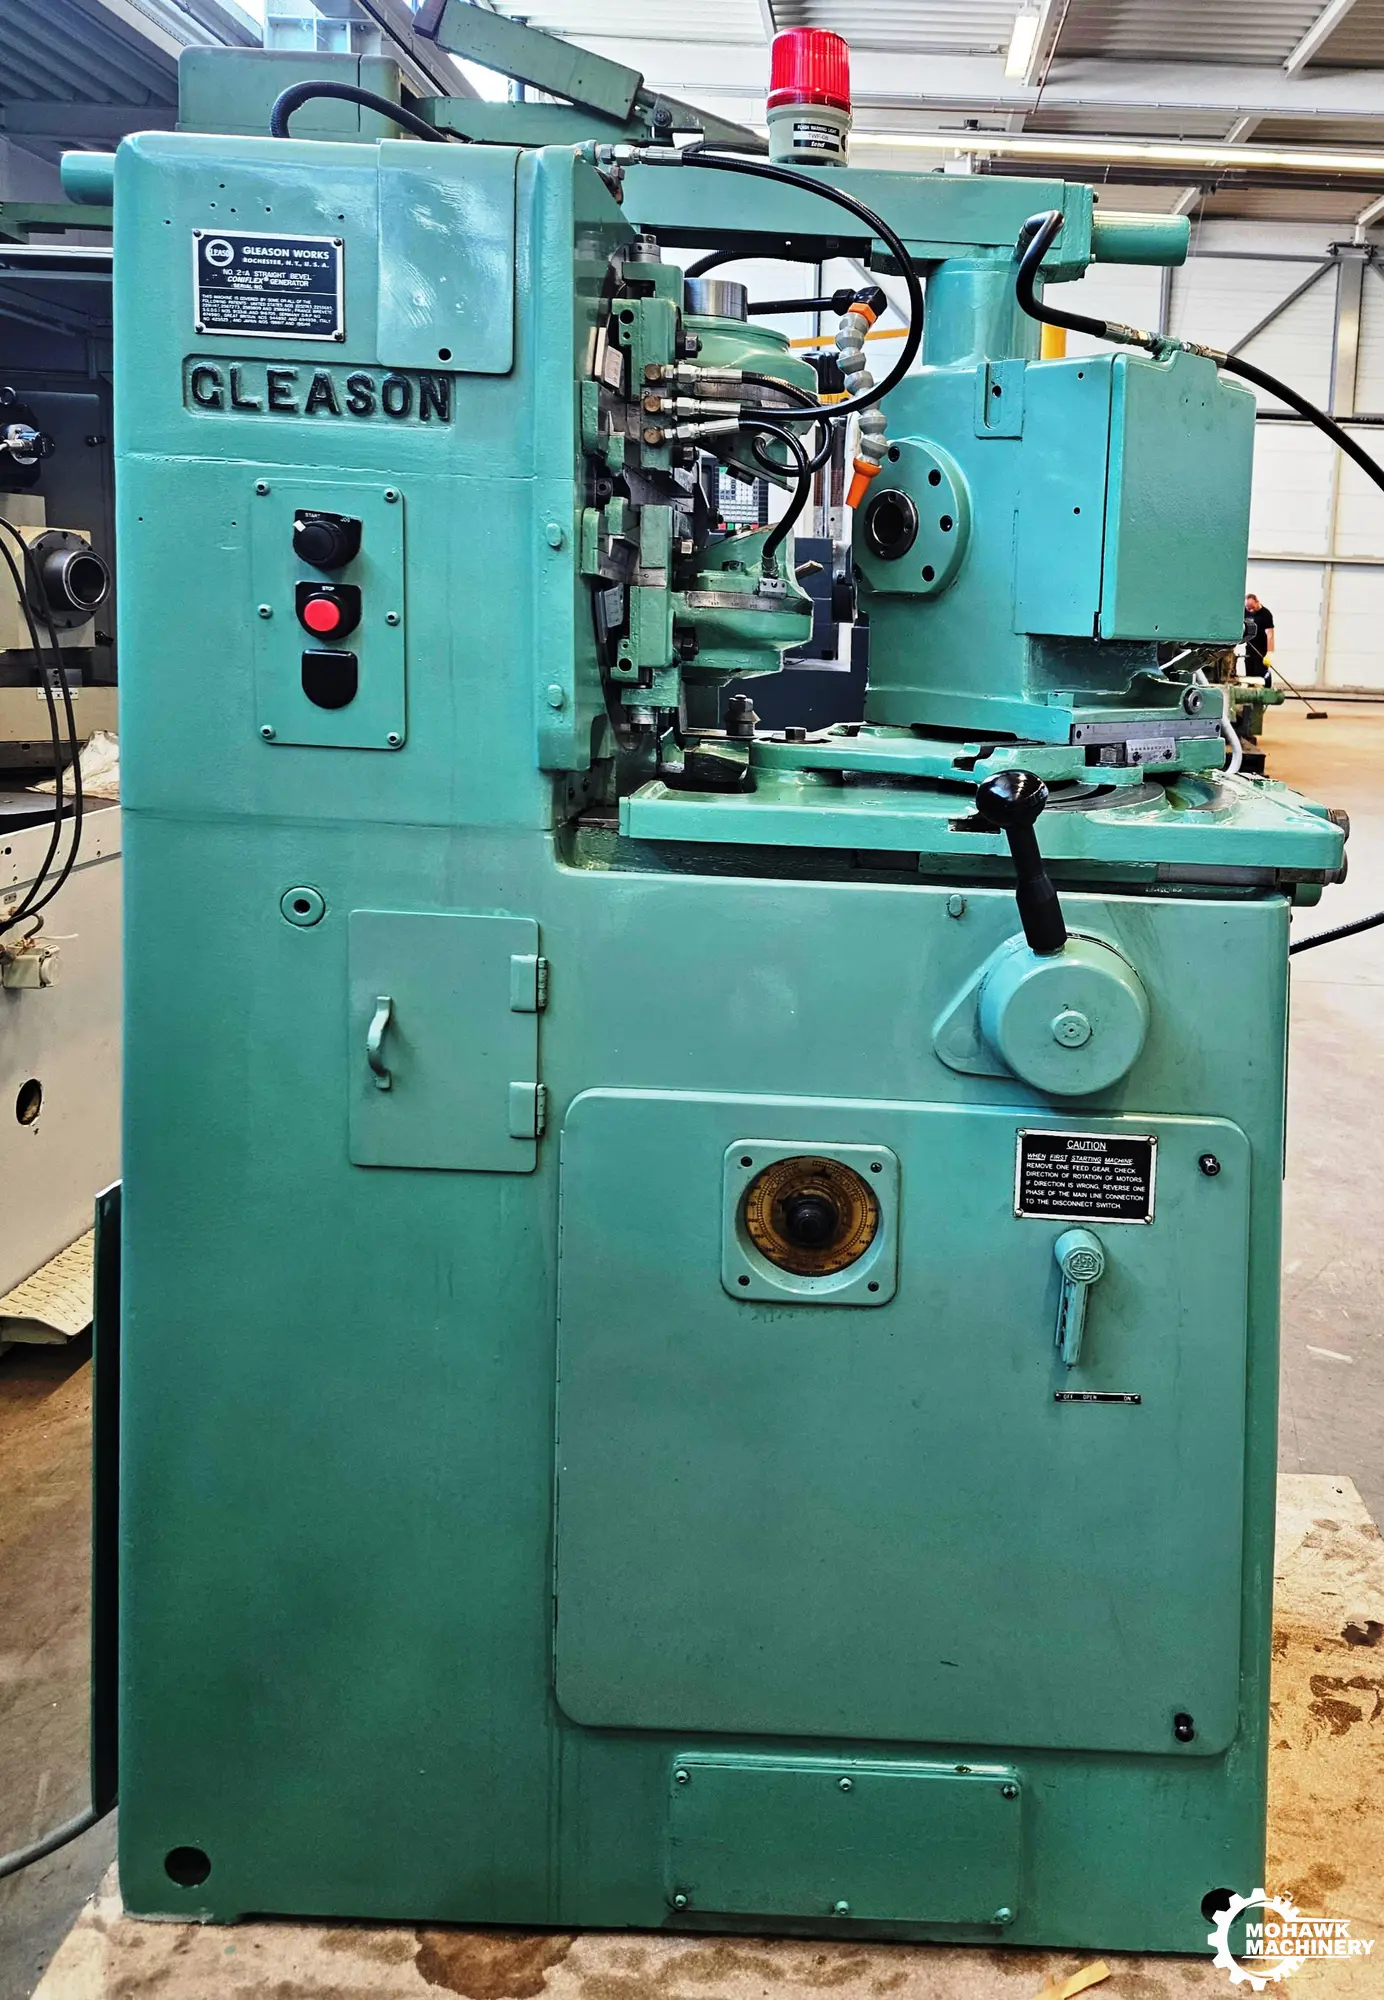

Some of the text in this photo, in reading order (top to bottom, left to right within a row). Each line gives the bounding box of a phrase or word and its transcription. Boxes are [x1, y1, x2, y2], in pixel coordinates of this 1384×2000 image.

[243, 246, 330, 260] GLEASON WORKS
[243, 258, 284, 266] ROCHESTER,
[191, 361, 452, 421] GLEASON
[1067, 1140, 1107, 1150] CAUTION
[1071, 1155, 1102, 1163] STARTING
[1073, 1173, 1102, 1181] ROTATION
